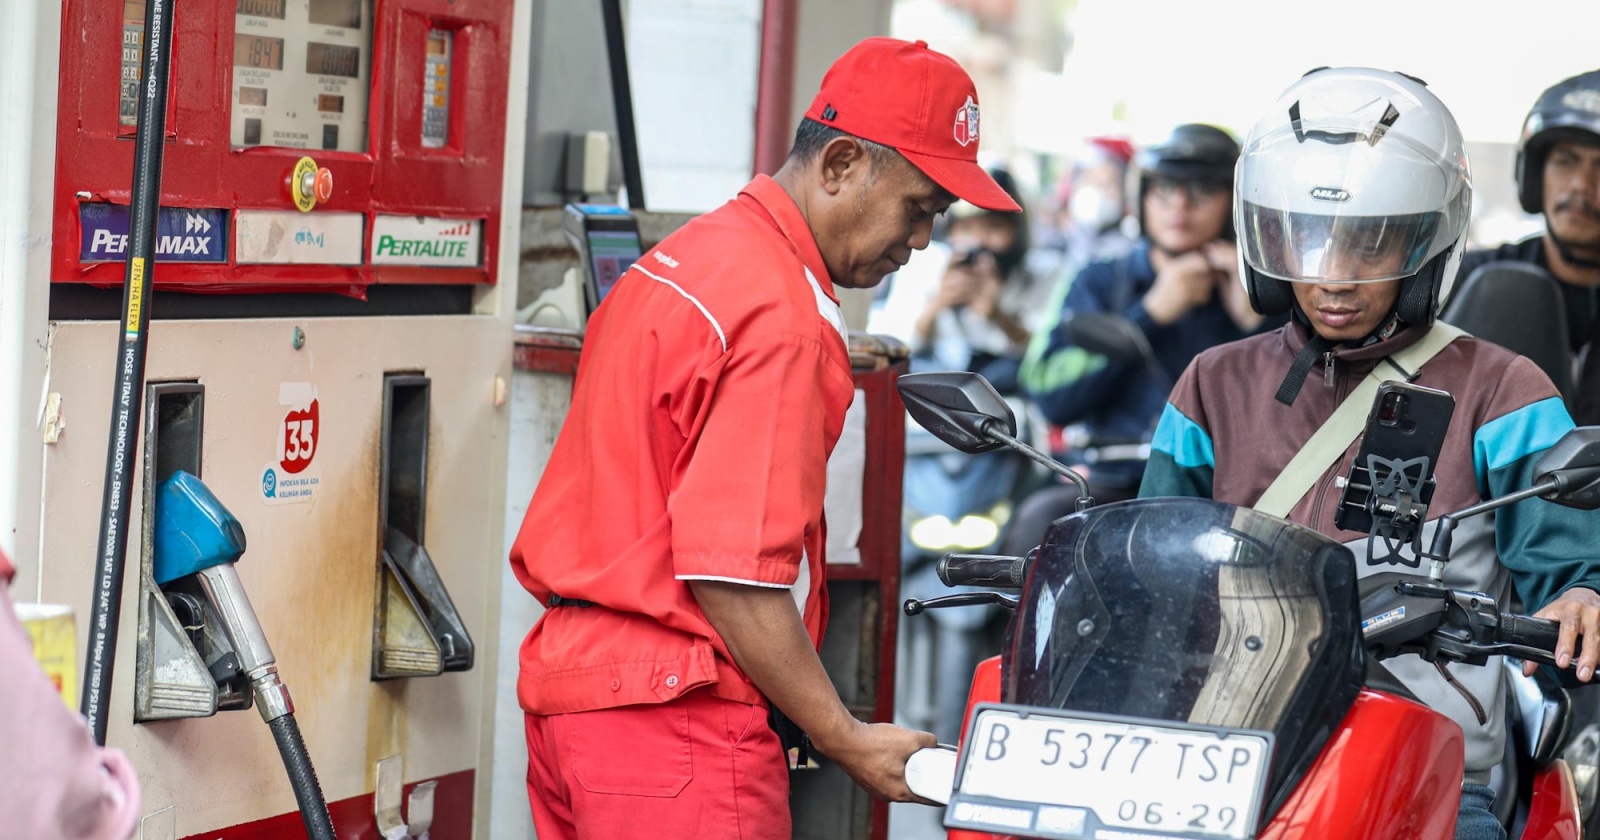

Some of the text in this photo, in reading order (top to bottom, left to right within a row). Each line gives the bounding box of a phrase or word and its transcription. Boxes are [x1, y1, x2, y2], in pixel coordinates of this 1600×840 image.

[150, 13, 161, 61] RESISTANT
[90, 229, 212, 255] PERMAX
[376, 234, 468, 257] PERTALITE
[128, 303, 139, 326] FLEX
[124, 348, 134, 375] HOSE
[121, 381, 132, 406] ITALY
[115, 409, 128, 475] TECHNOLOGY
[110, 481, 121, 511] EN853
[102, 575, 112, 589] LD
[98, 613, 107, 630] WP
[984, 723, 1250, 784] B 5377 TSP
